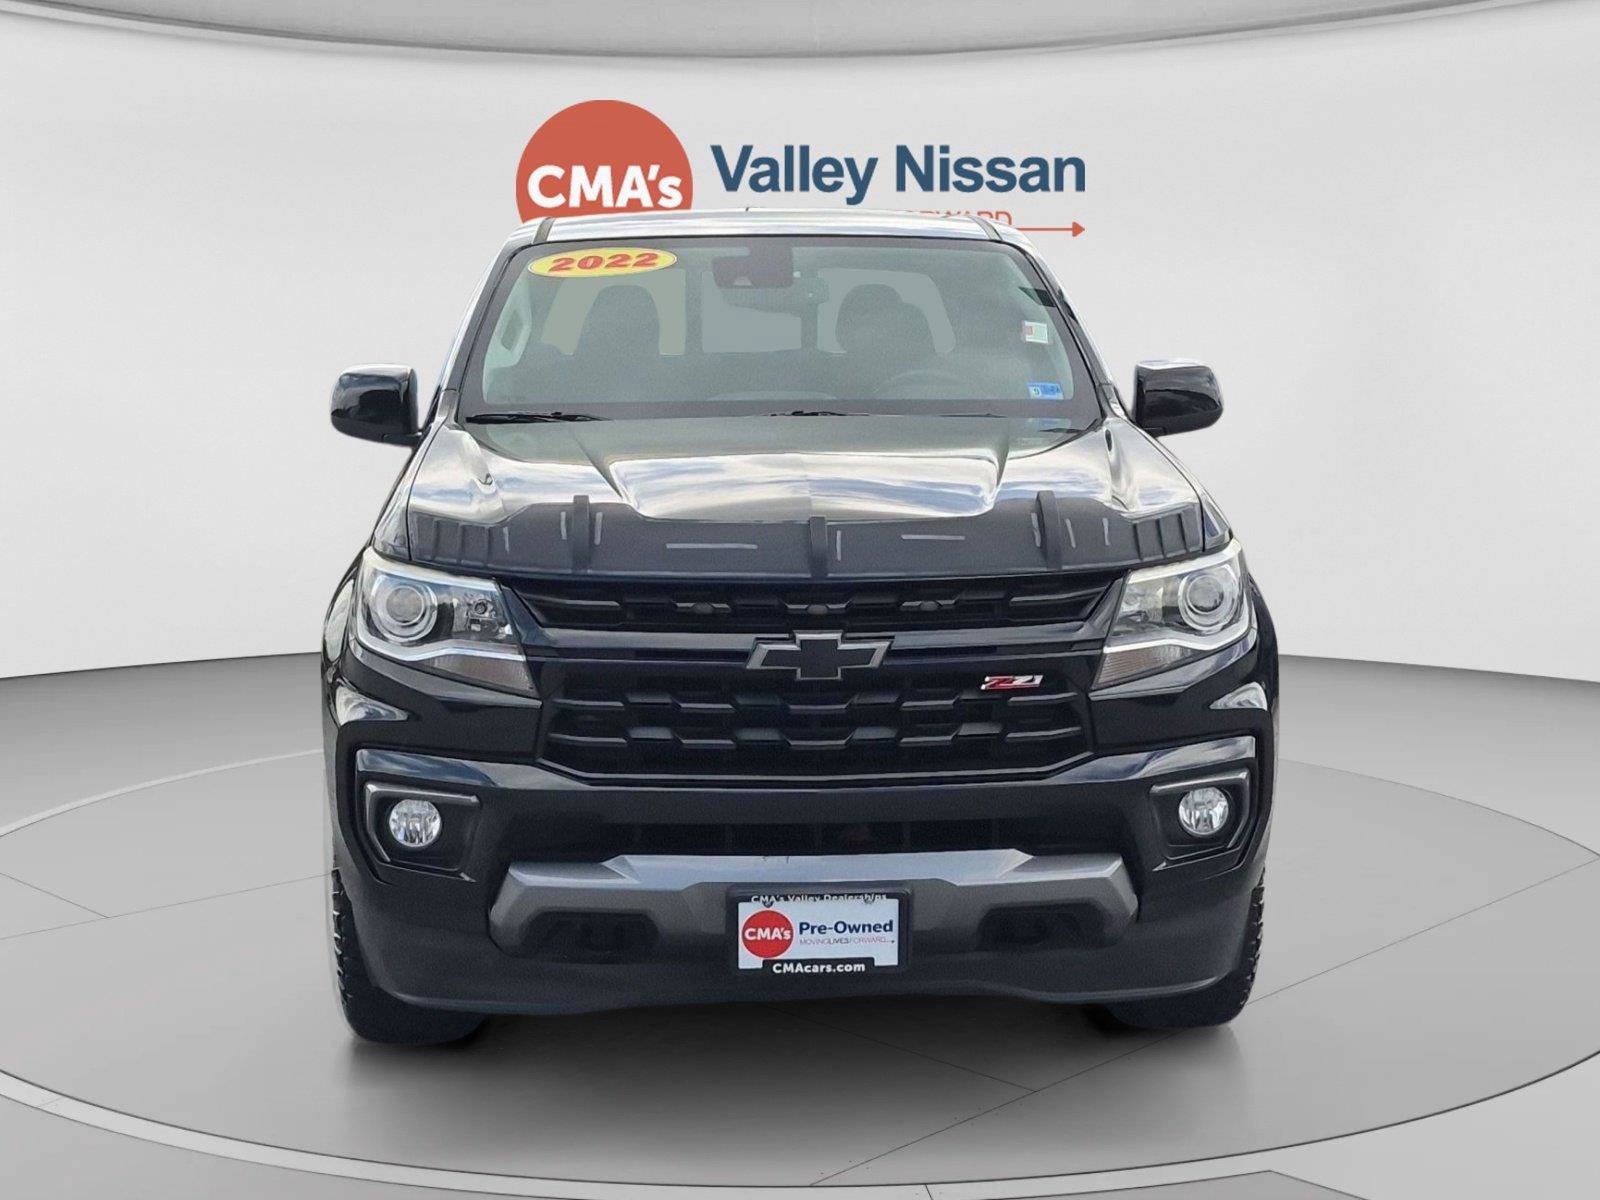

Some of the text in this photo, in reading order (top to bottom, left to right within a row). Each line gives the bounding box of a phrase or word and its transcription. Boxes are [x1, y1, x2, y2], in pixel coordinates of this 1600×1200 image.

[710, 144, 1086, 205] Valley Nissan
[527, 164, 684, 209] CMA's
[548, 252, 660, 273] 2022
[744, 927, 792, 941] CMA's
[799, 920, 894, 935] Pre-Owned
[772, 961, 866, 974] CMAcars.com
